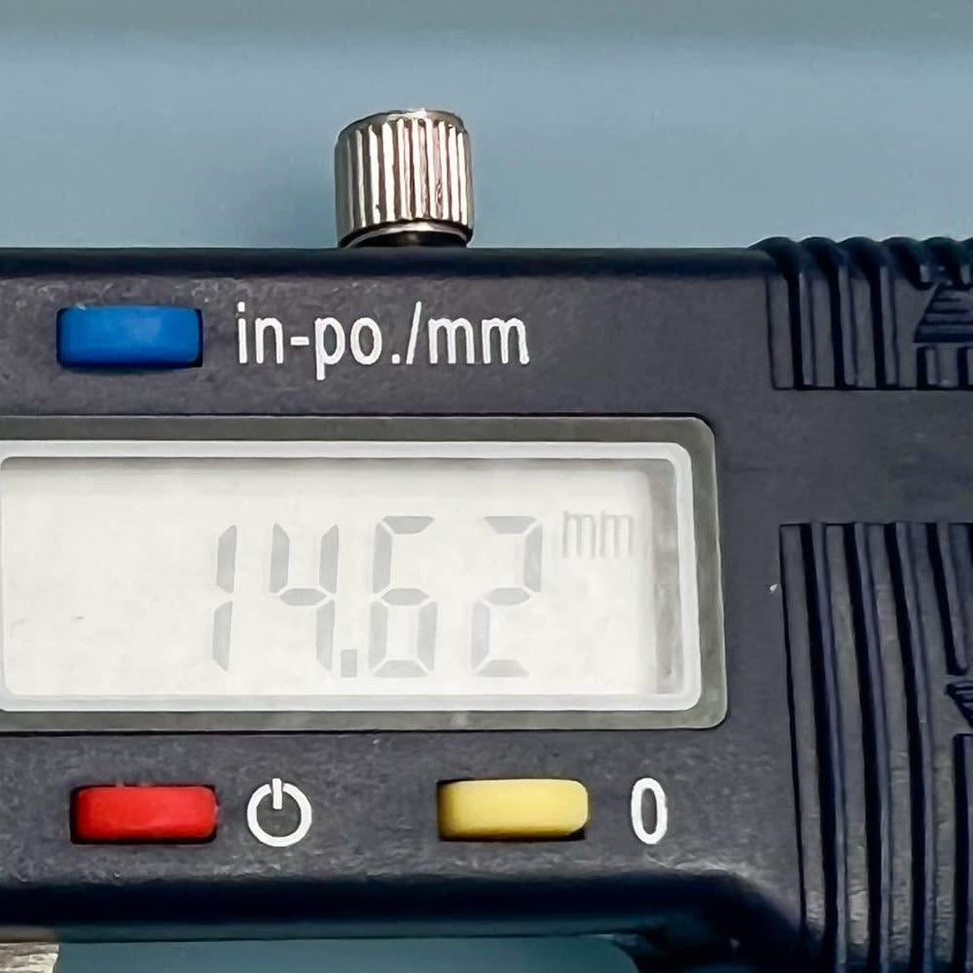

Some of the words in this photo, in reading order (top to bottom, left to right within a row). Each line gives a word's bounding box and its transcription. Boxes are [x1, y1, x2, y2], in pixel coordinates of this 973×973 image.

[236, 300, 530, 381] in-po./mm
[211, 515, 544, 678] 14.62
[562, 509, 634, 560] mm
[630, 776, 668, 845] 0
